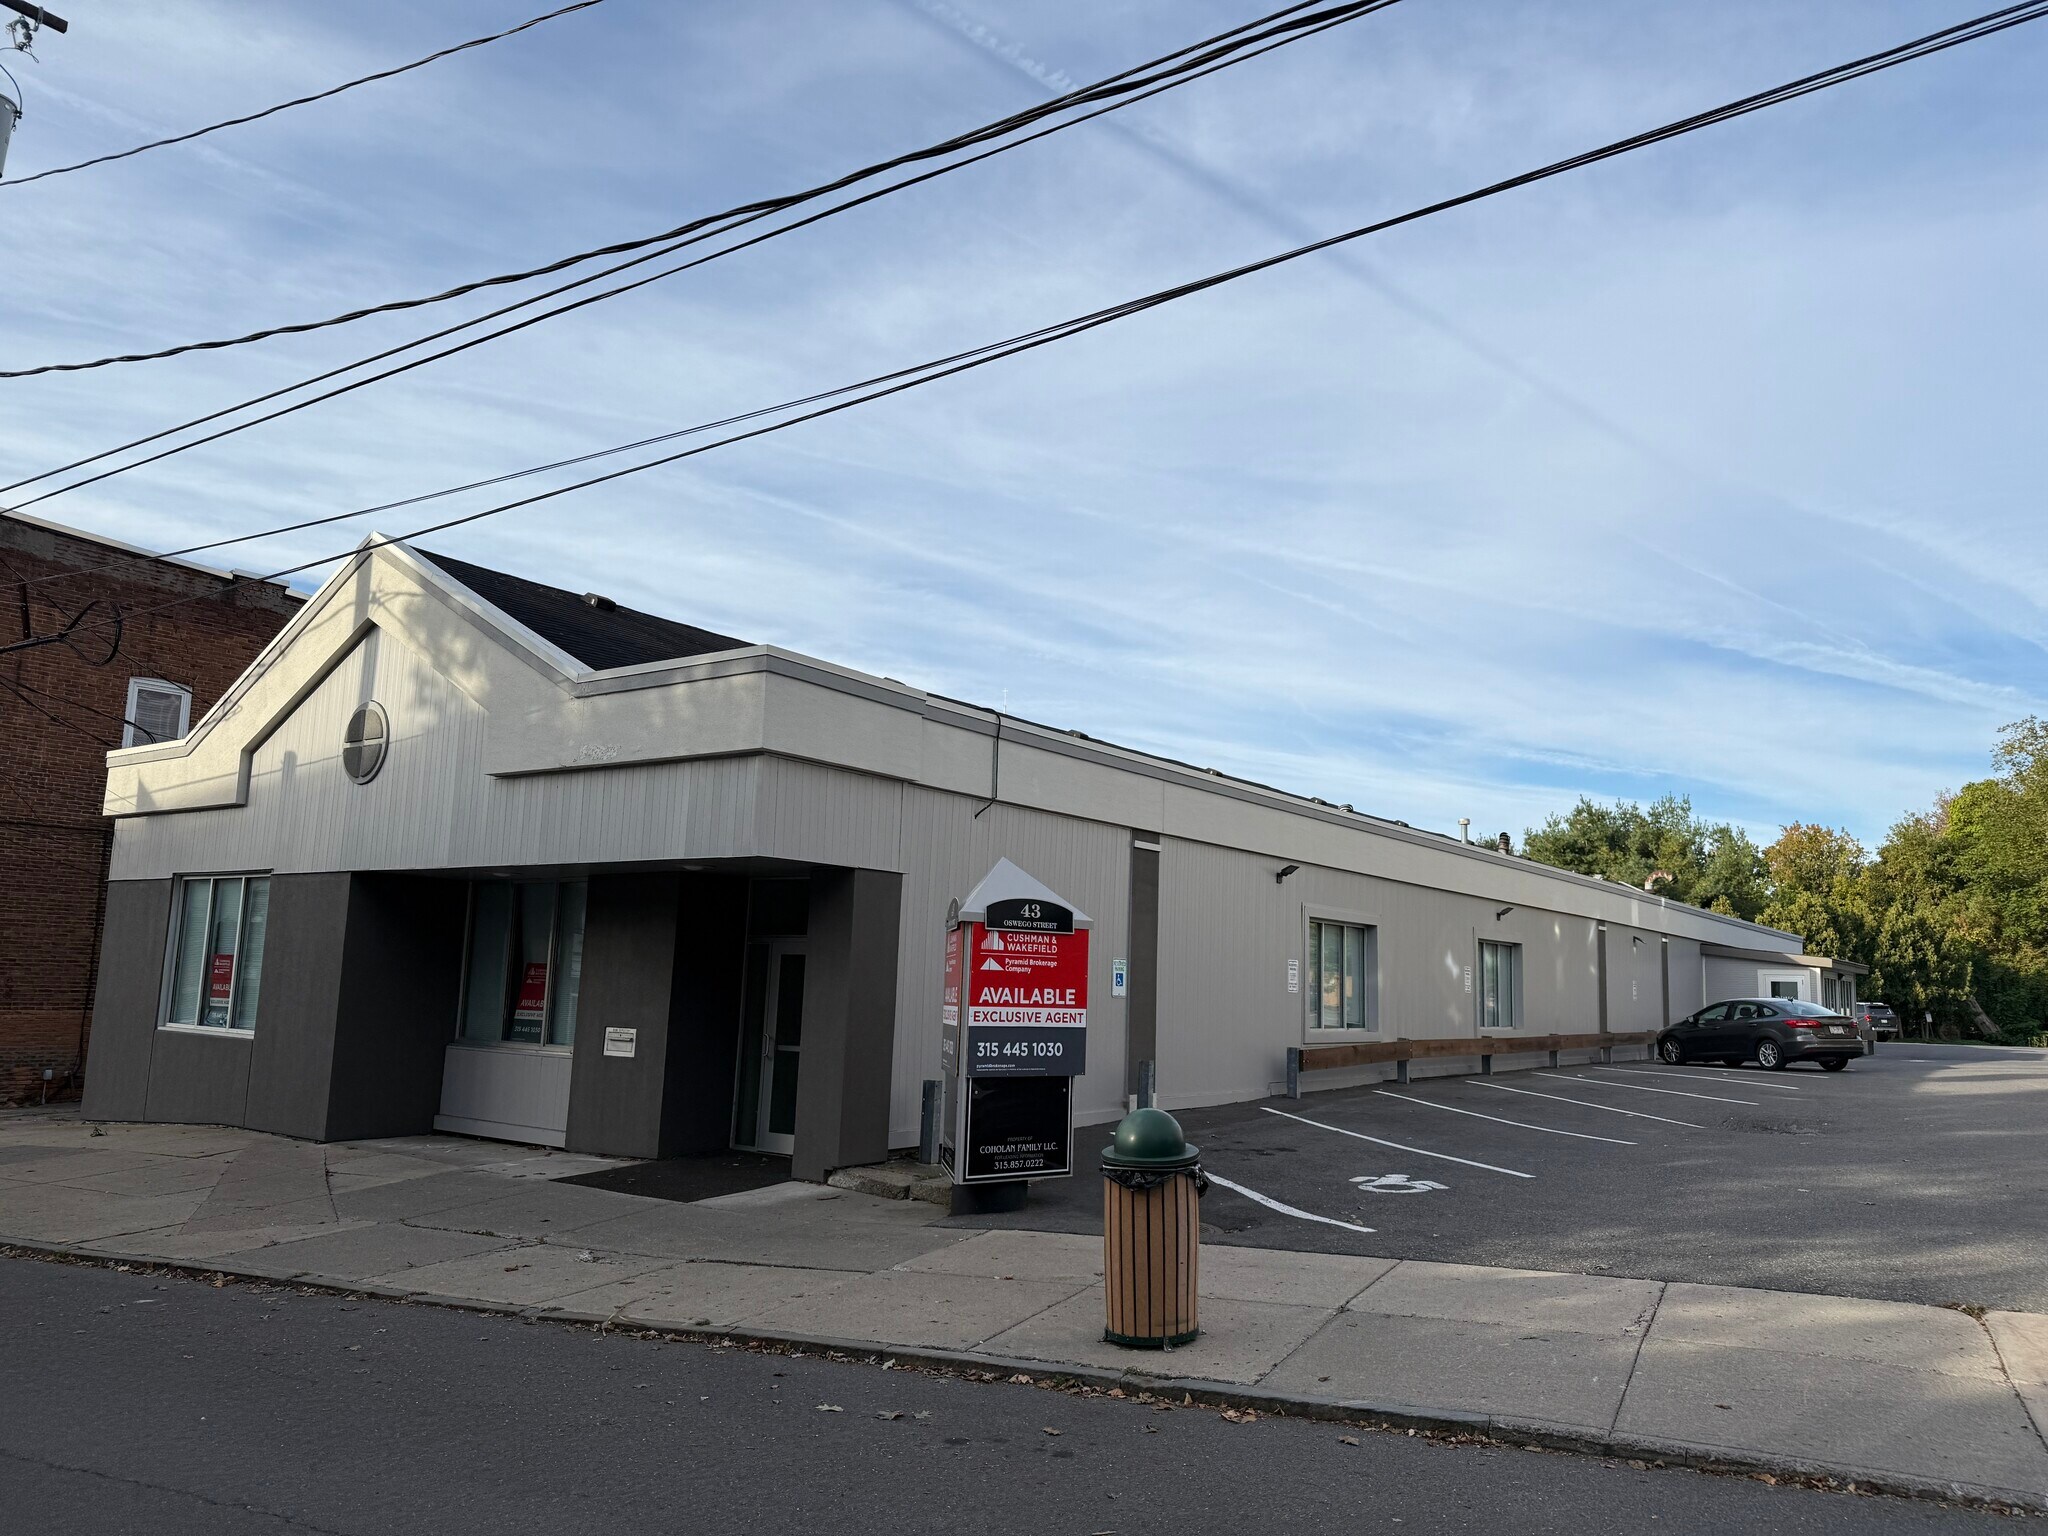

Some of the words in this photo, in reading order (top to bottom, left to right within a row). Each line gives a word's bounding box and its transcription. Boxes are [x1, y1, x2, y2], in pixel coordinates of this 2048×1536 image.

[1020, 903, 1041, 918] 43
[1003, 919, 1032, 928] OSWEGO
[1032, 921, 1058, 929] STREET
[1007, 933, 1050, 944] CUSHMAN
[1051, 936, 1057, 944] &
[1007, 943, 1058, 954] WAKEFIELD
[1005, 957, 1029, 967] Pyramid
[1029, 958, 1058, 967] Brokerage
[1005, 965, 1032, 974] Company
[978, 987, 1076, 1005] AVAILABLE
[973, 1010, 1042, 1023] EXCLUSIVE
[1045, 1012, 1084, 1024] AGENT
[976, 1042, 999, 1057] 315
[1002, 1042, 1029, 1057] 445
[1032, 1042, 1063, 1057] 1030
[979, 1144, 1016, 1154] COHOLAN
[1017, 1142, 1042, 1152] FAMILY
[1043, 1141, 1059, 1151] LLC.
[993, 1158, 1044, 1170] 315.857.0222
